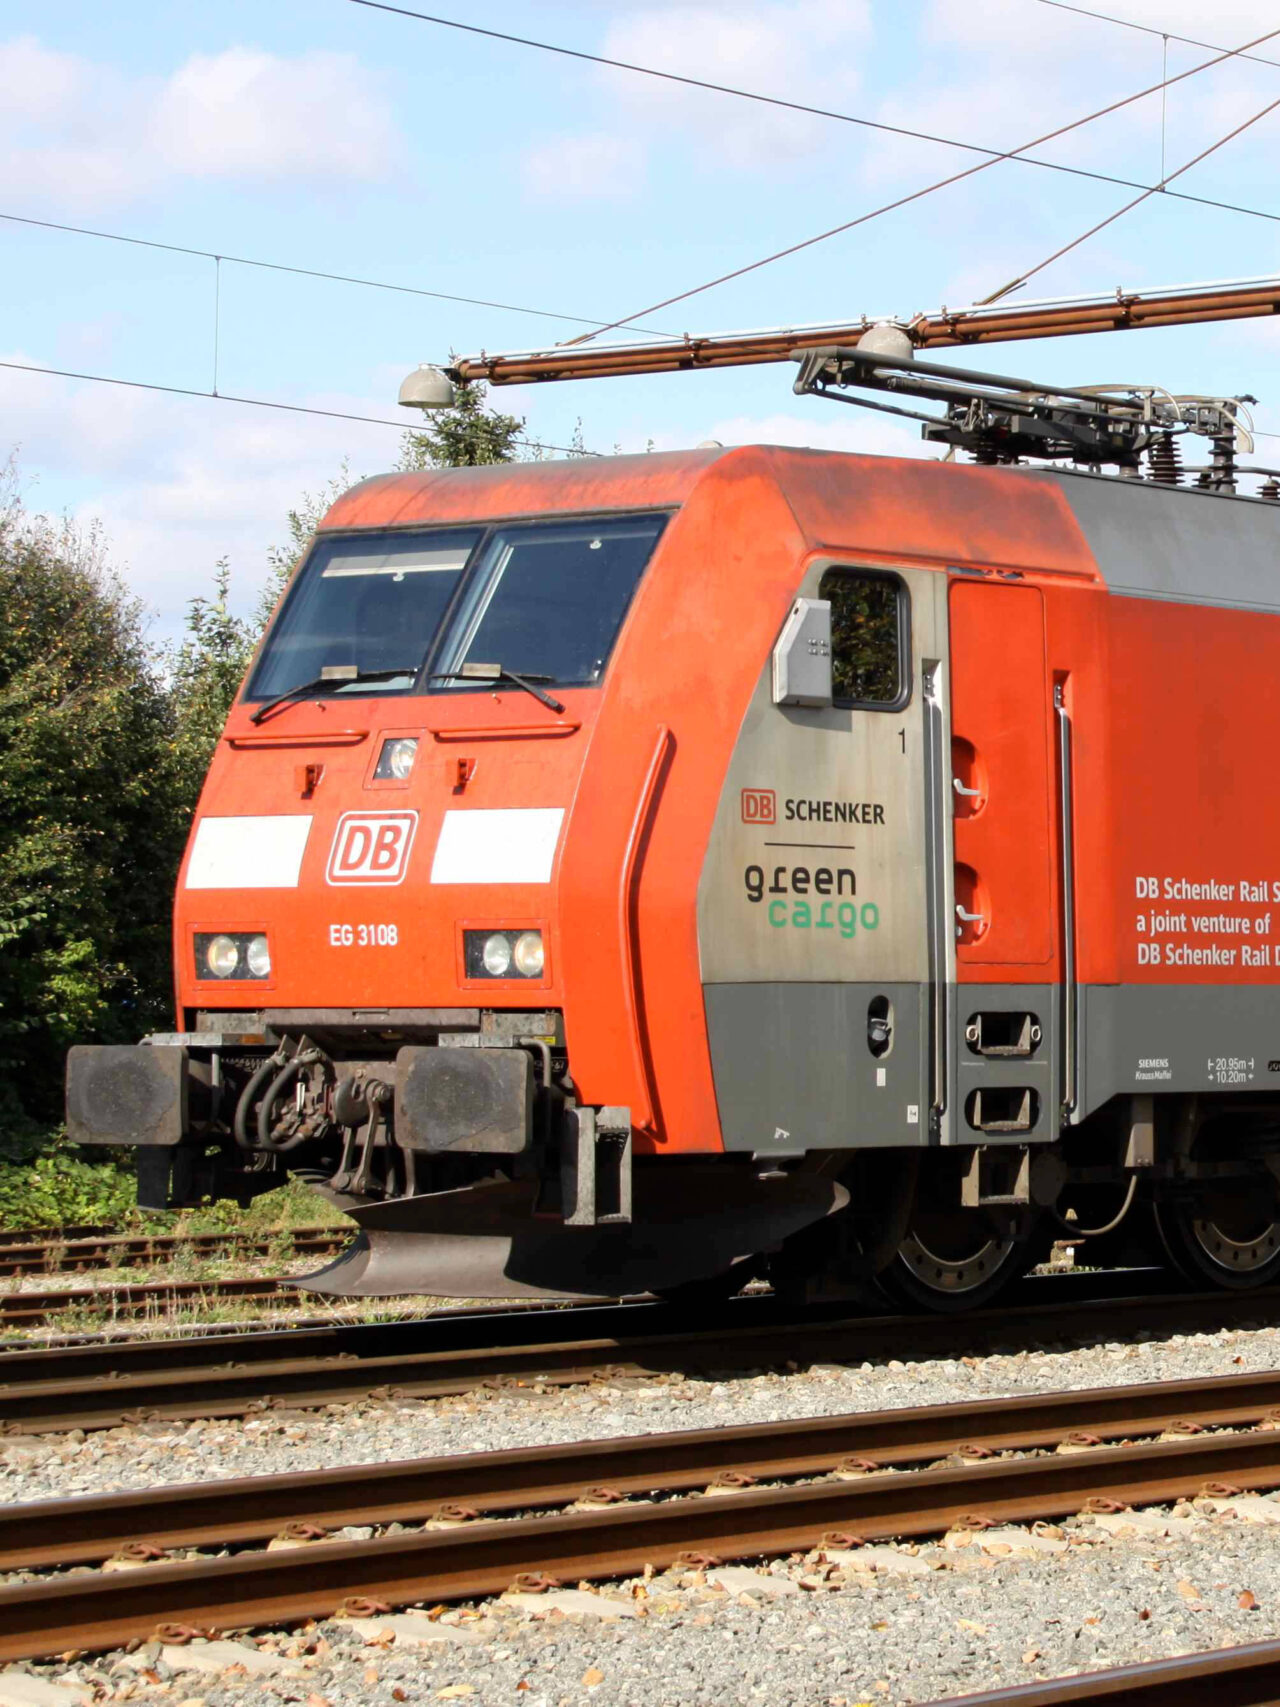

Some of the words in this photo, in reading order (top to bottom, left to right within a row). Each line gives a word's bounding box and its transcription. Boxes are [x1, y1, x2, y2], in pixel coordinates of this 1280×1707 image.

[897, 727, 907, 754] 1
[744, 794, 773, 819] DB
[785, 798, 886, 825] SCHENKER
[338, 824, 403, 872] DB
[744, 864, 857, 902] green
[1135, 876, 1160, 899] DB
[1163, 878, 1235, 901] Schenker
[1239, 881, 1269, 902] Rail
[768, 900, 880, 938] cargo
[1136, 914, 1146, 932] a
[1150, 910, 1187, 937] joint
[1191, 914, 1251, 934] venture
[1254, 913, 1271, 935] of
[329, 924, 354, 946] EG
[357, 924, 399, 946] 3108
[1137, 943, 1161, 965] DB
[1164, 943, 1237, 966] Schenker
[1241, 945, 1270, 967] Rail
[1138, 1058, 1169, 1068] SIEMENS
[1215, 1057, 1247, 1071] 20.95m
[1216, 1071, 1246, 1083] 10.20m
